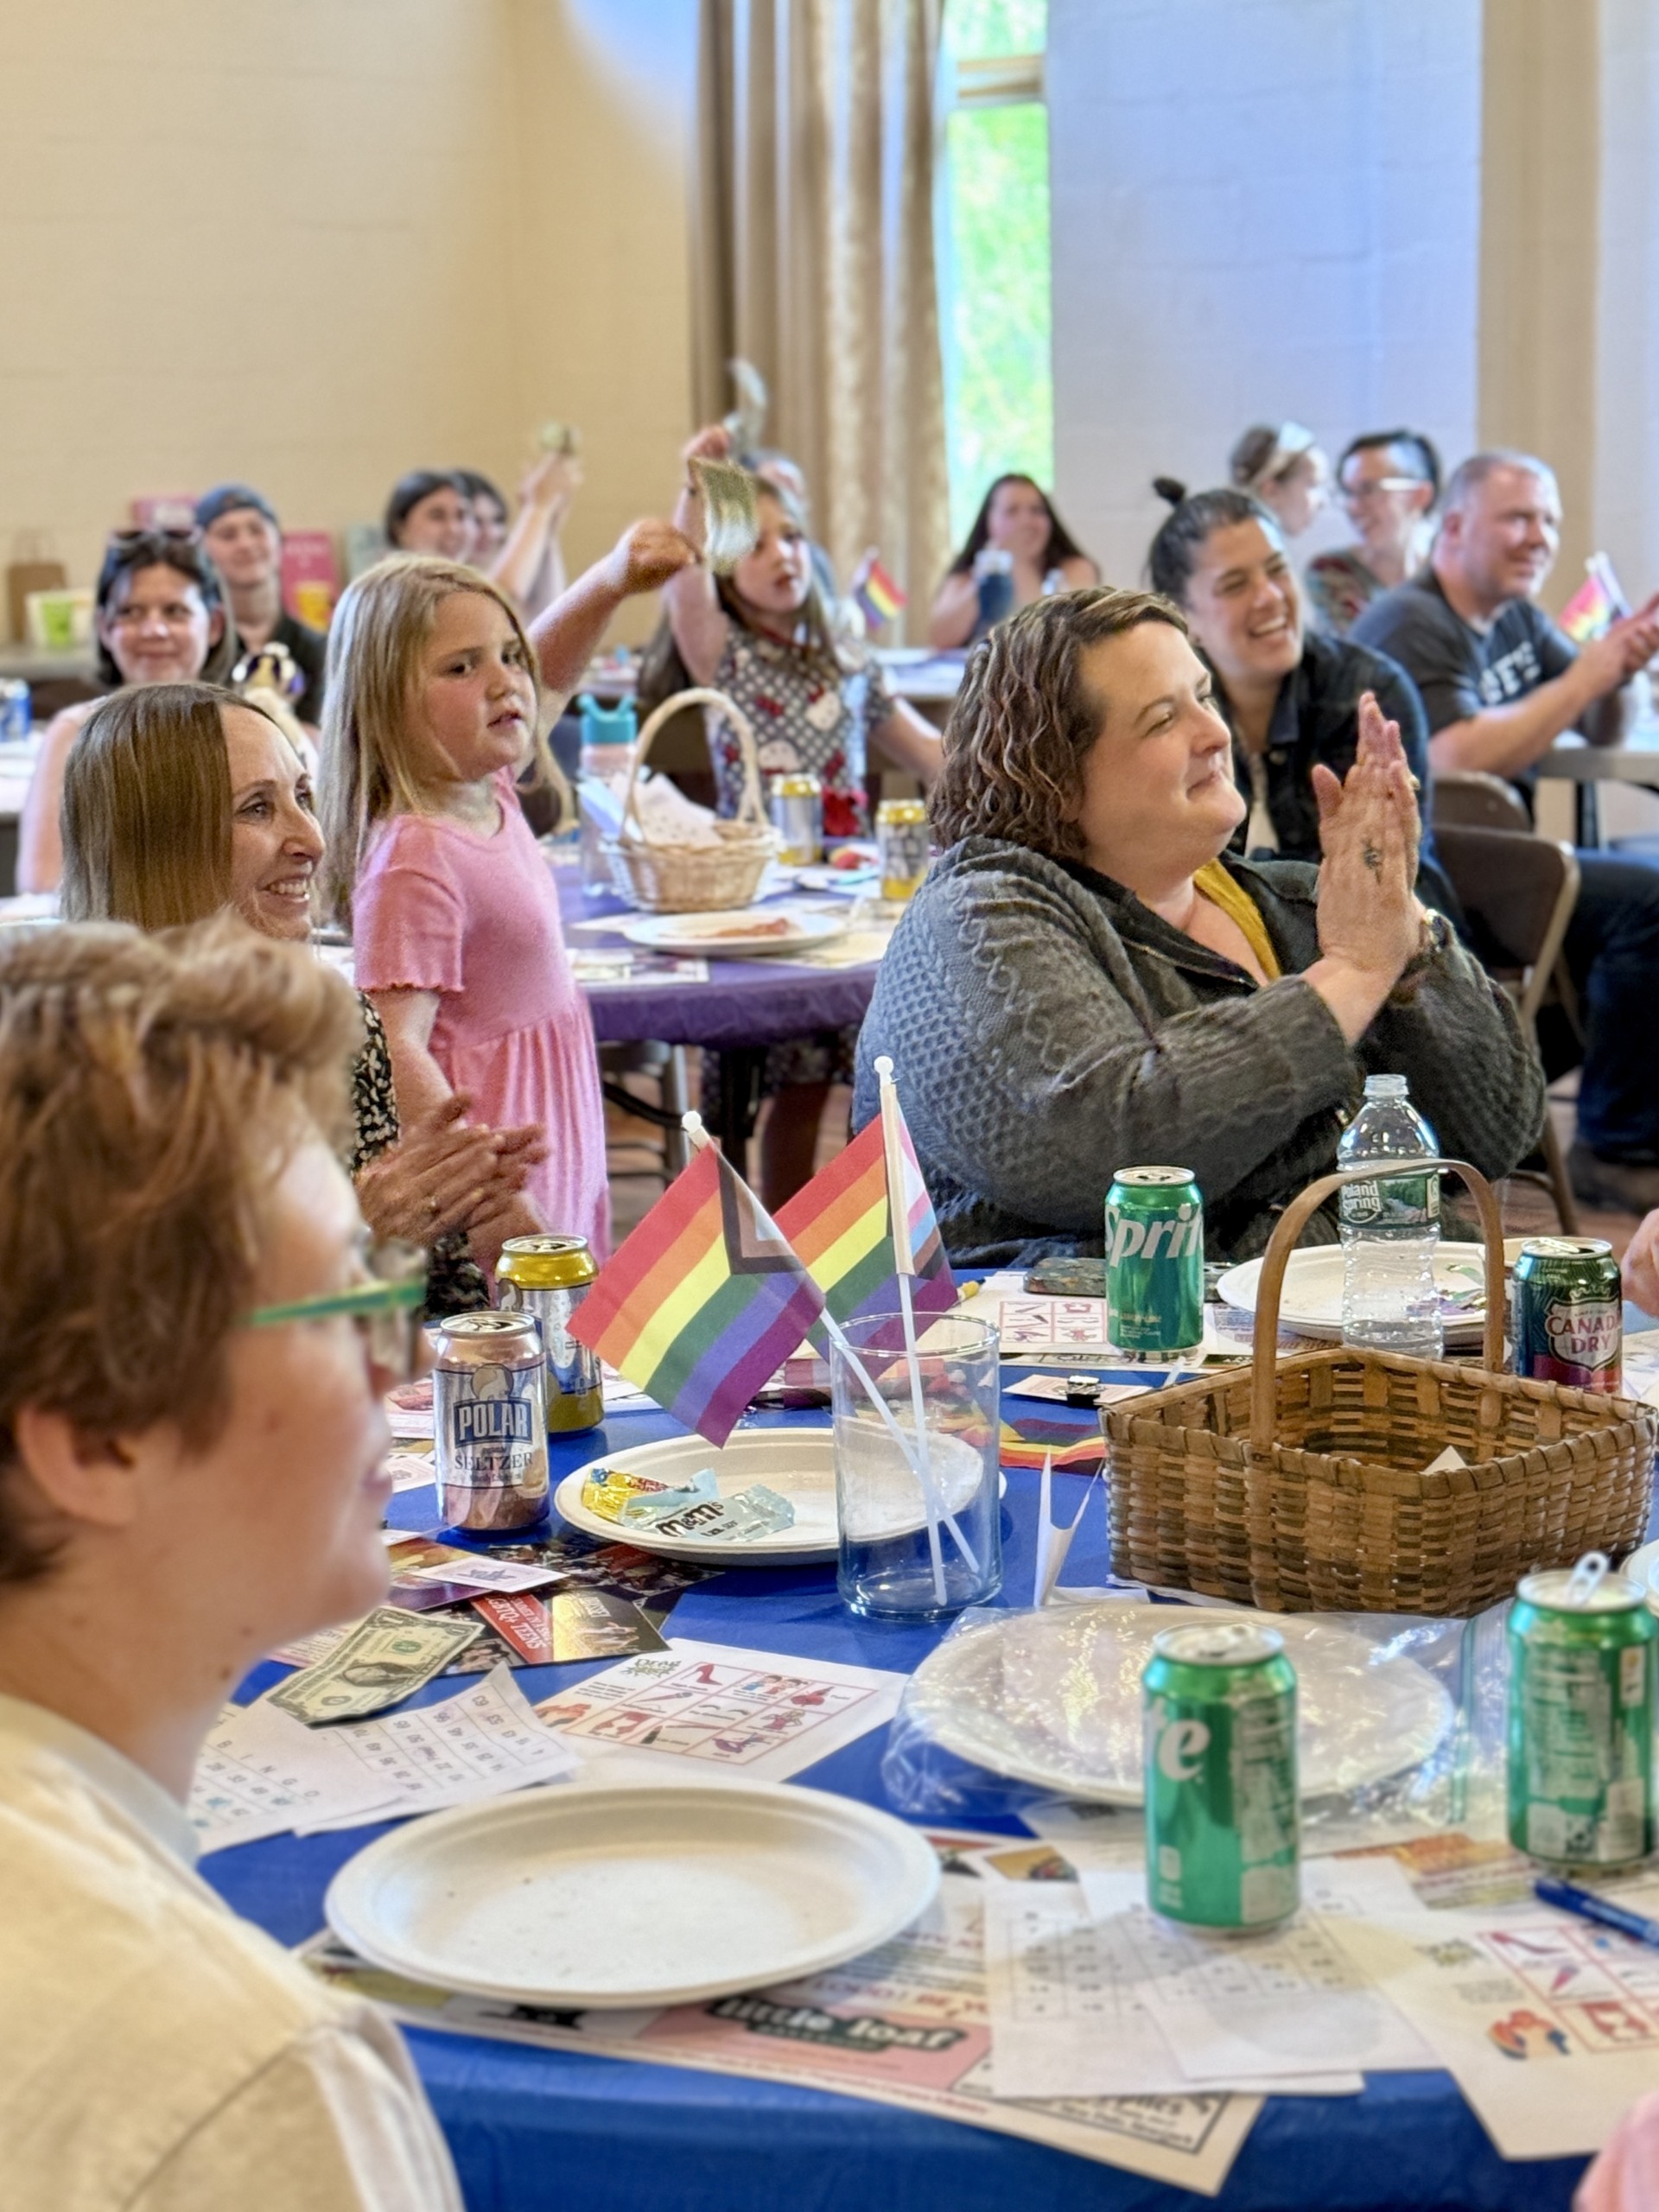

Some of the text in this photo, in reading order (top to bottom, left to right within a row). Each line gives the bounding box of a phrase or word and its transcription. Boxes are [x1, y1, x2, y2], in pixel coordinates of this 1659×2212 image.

[1571, 1334, 1611, 1354] DRY
[458, 1402, 529, 1441] POLAR
[454, 1452, 534, 1471] SELTZER
[510, 1622, 547, 1649] TEENS
